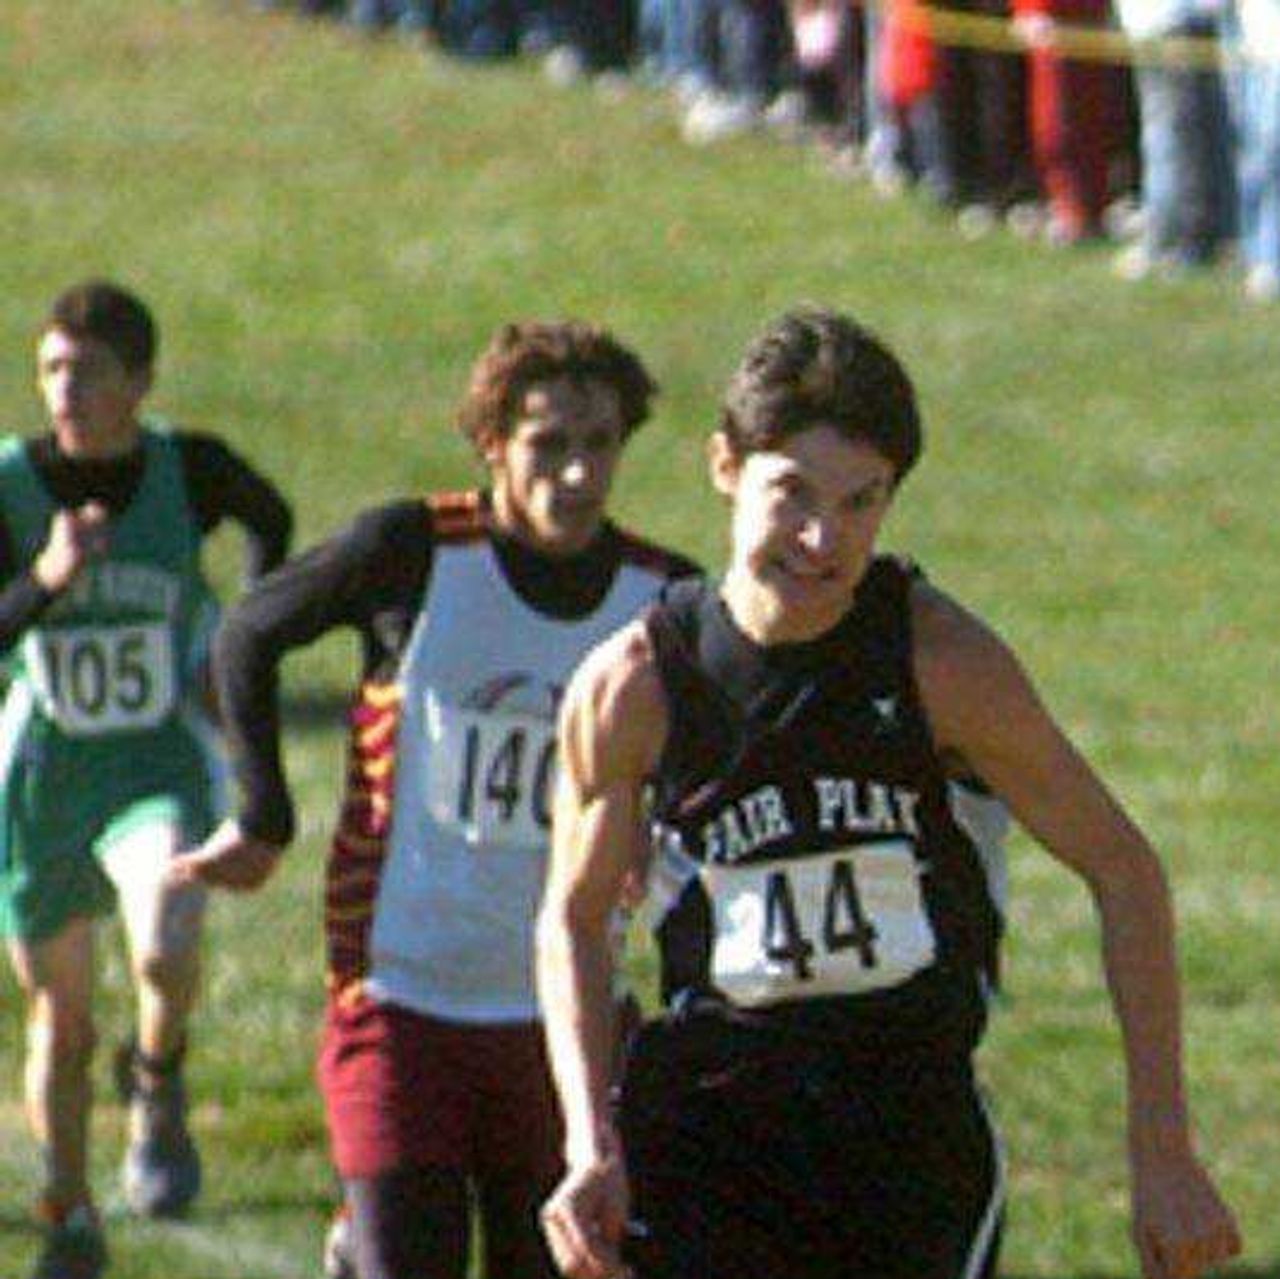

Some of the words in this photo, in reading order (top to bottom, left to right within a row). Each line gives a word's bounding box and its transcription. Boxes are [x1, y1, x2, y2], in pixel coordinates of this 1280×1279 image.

[46, 632, 152, 717] 105
[704, 784, 793, 866] FAIR
[814, 777, 921, 838] PLAY
[762, 858, 877, 979] 44
